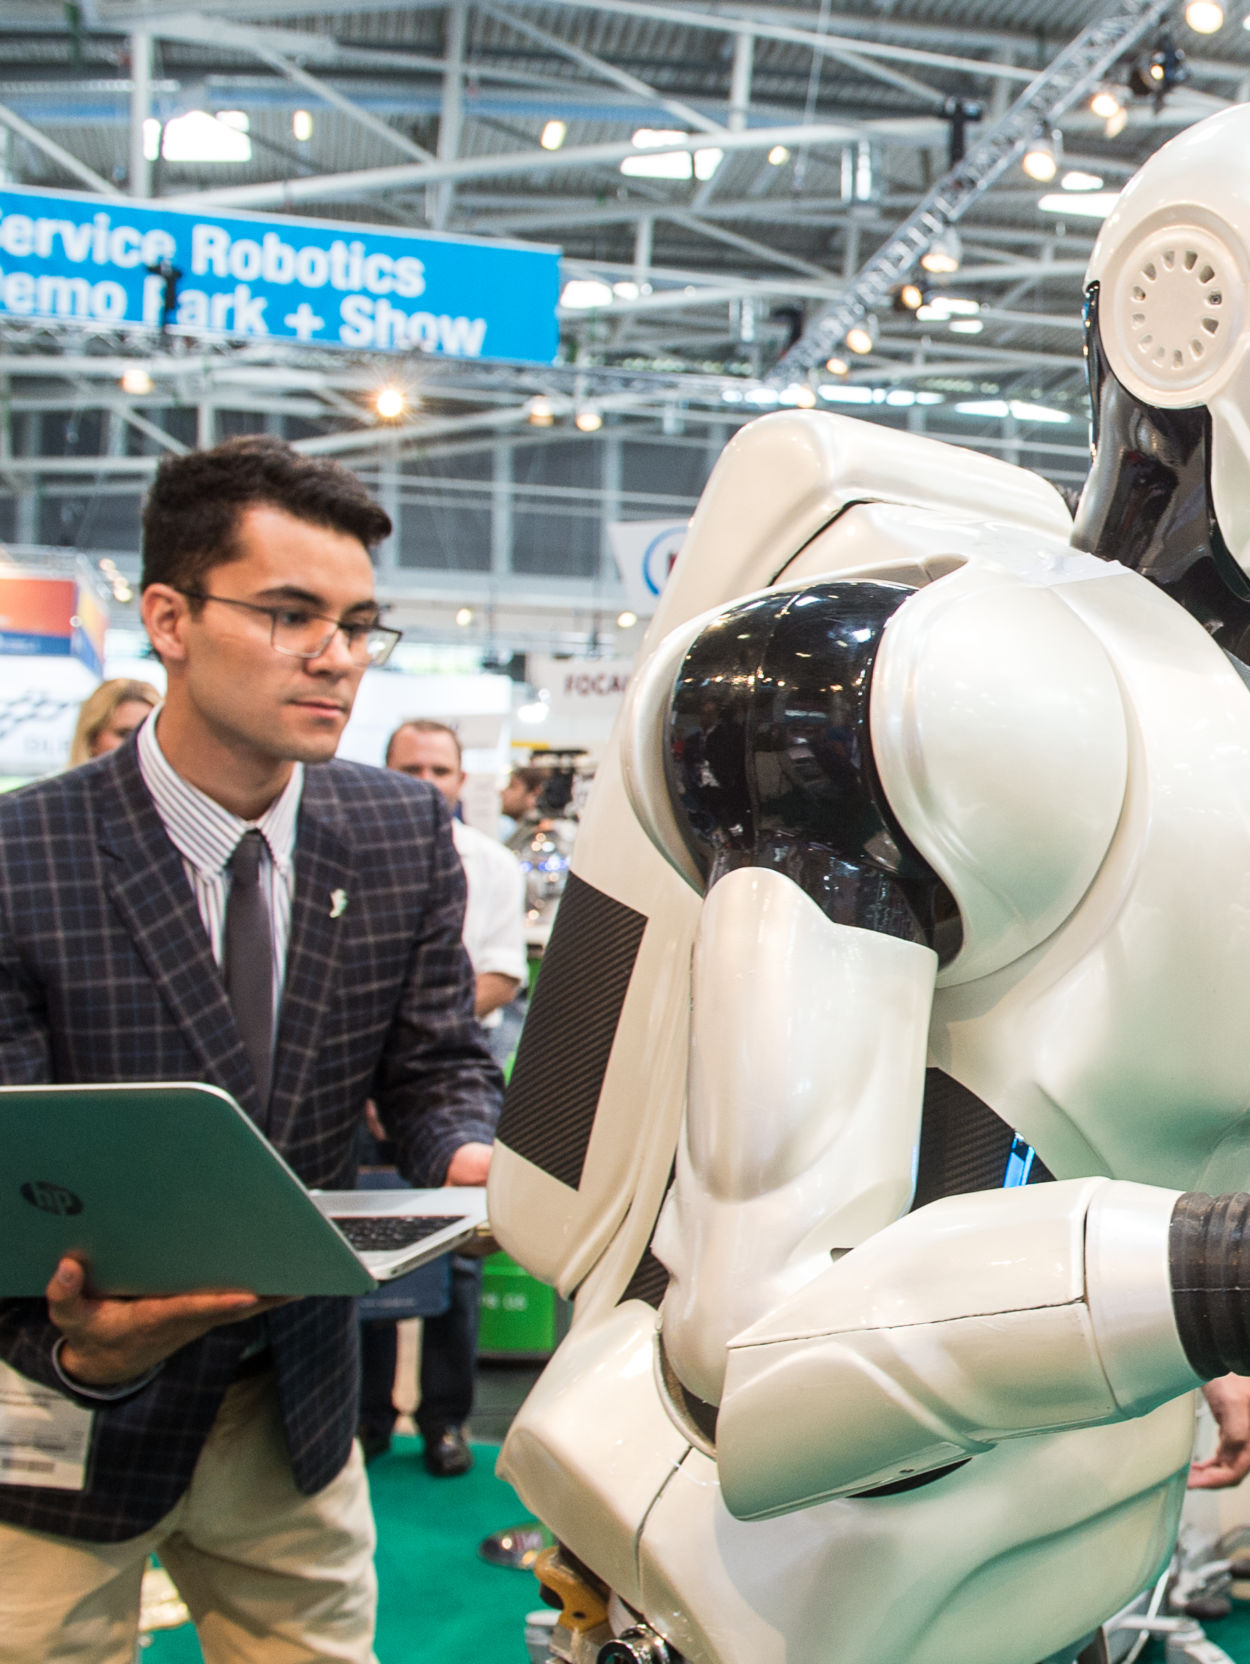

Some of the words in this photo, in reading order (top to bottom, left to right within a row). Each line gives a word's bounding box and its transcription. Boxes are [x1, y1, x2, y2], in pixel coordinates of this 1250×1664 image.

[0, 211, 176, 268] ervice
[190, 222, 427, 298] Robotics
[0, 265, 128, 322] emo
[283, 302, 326, 341] +
[338, 293, 488, 358] Show
